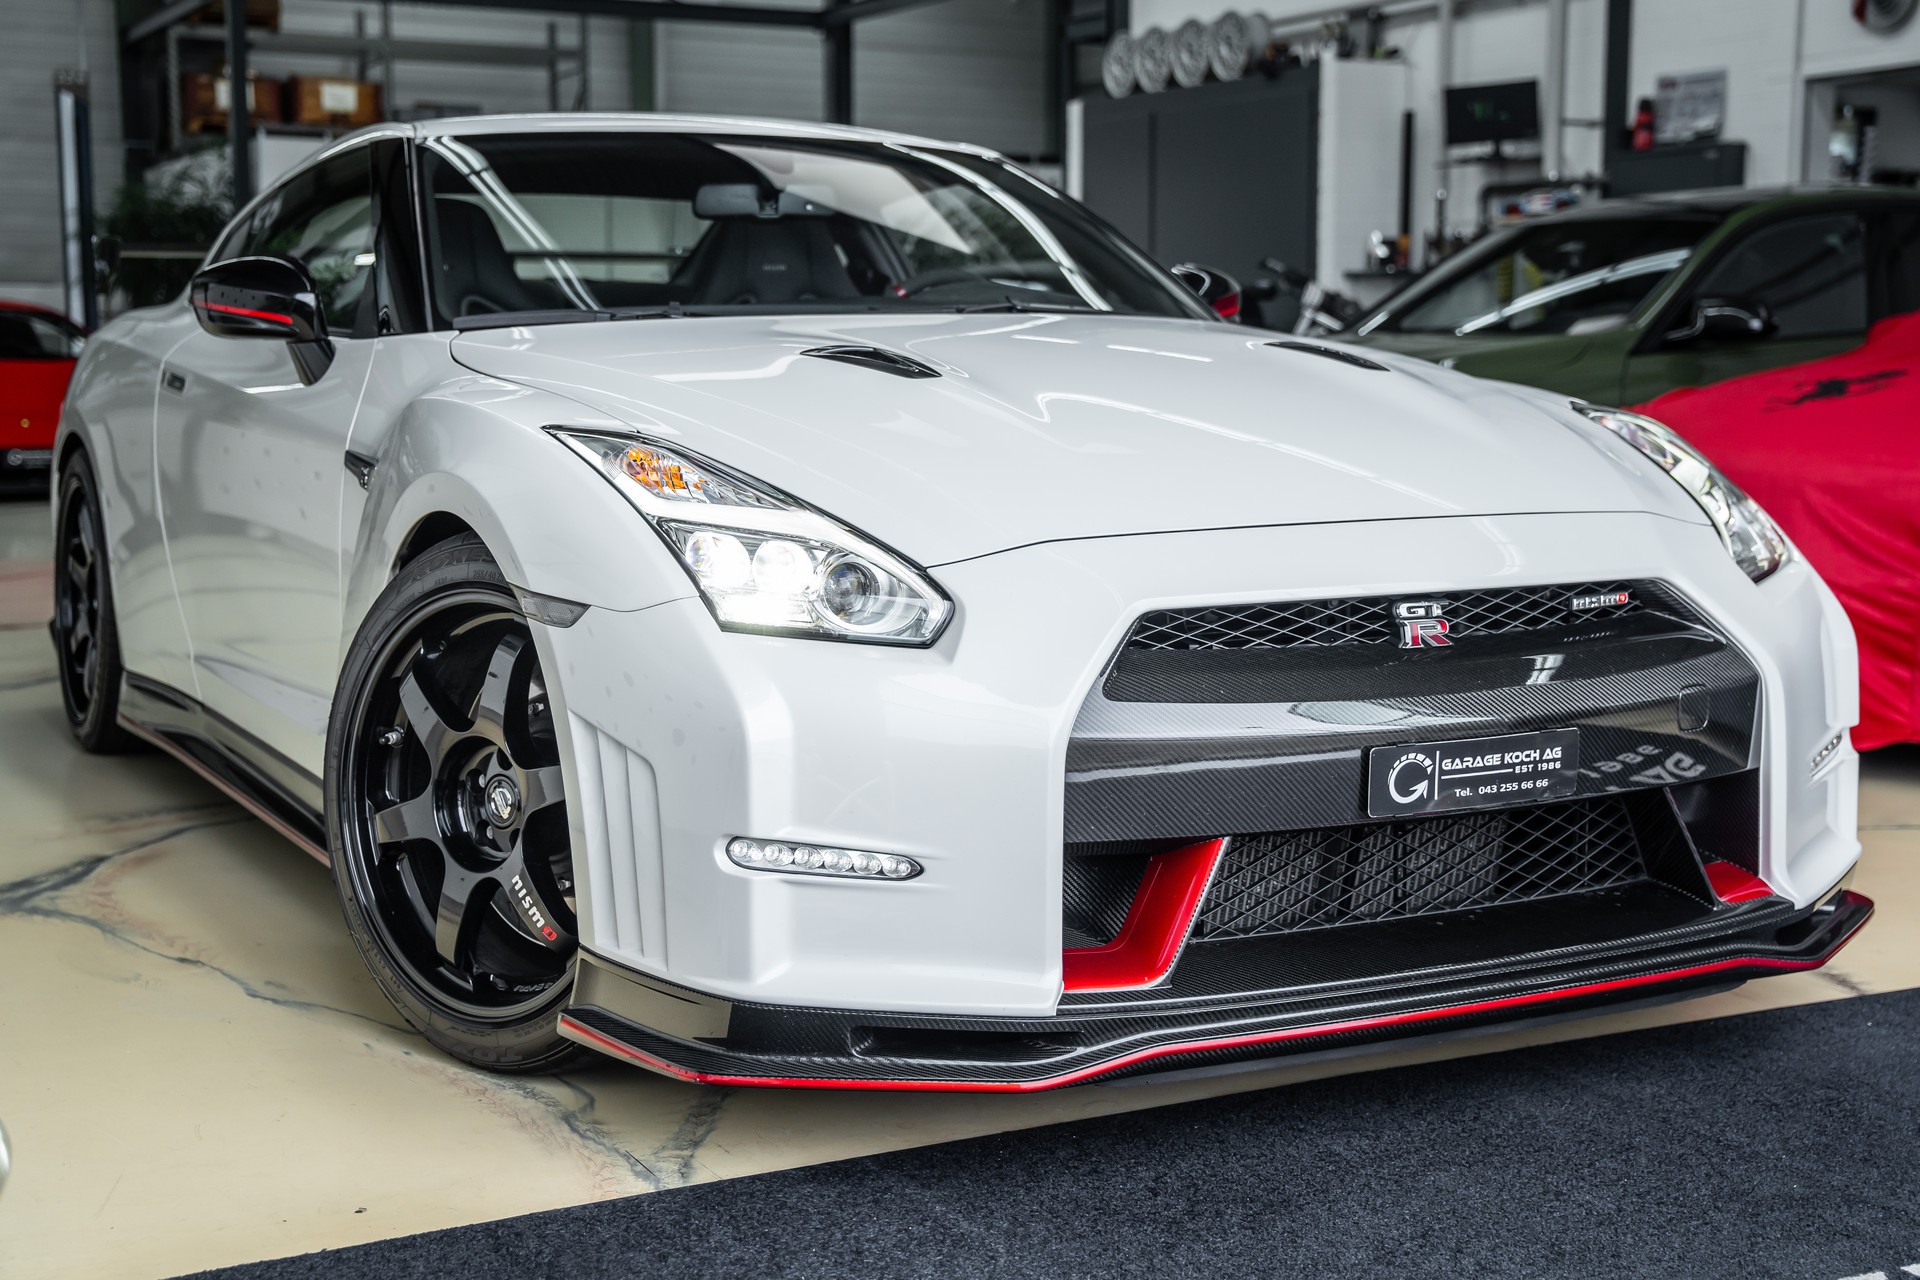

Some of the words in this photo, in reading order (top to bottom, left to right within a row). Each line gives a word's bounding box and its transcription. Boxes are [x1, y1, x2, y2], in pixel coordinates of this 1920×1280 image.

[1441, 753, 1502, 770] GARAGE
[1504, 749, 1540, 764] KOCH
[1542, 746, 1562, 760] AG
[1515, 764, 1534, 773] EST
[1537, 761, 1561, 771] 1986
[1455, 788, 1473, 797] Tel.
[1478, 785, 1497, 794] 043
[1499, 782, 1518, 792] 255
[1521, 780, 1534, 790] 66
[1535, 779, 1549, 788] 66
